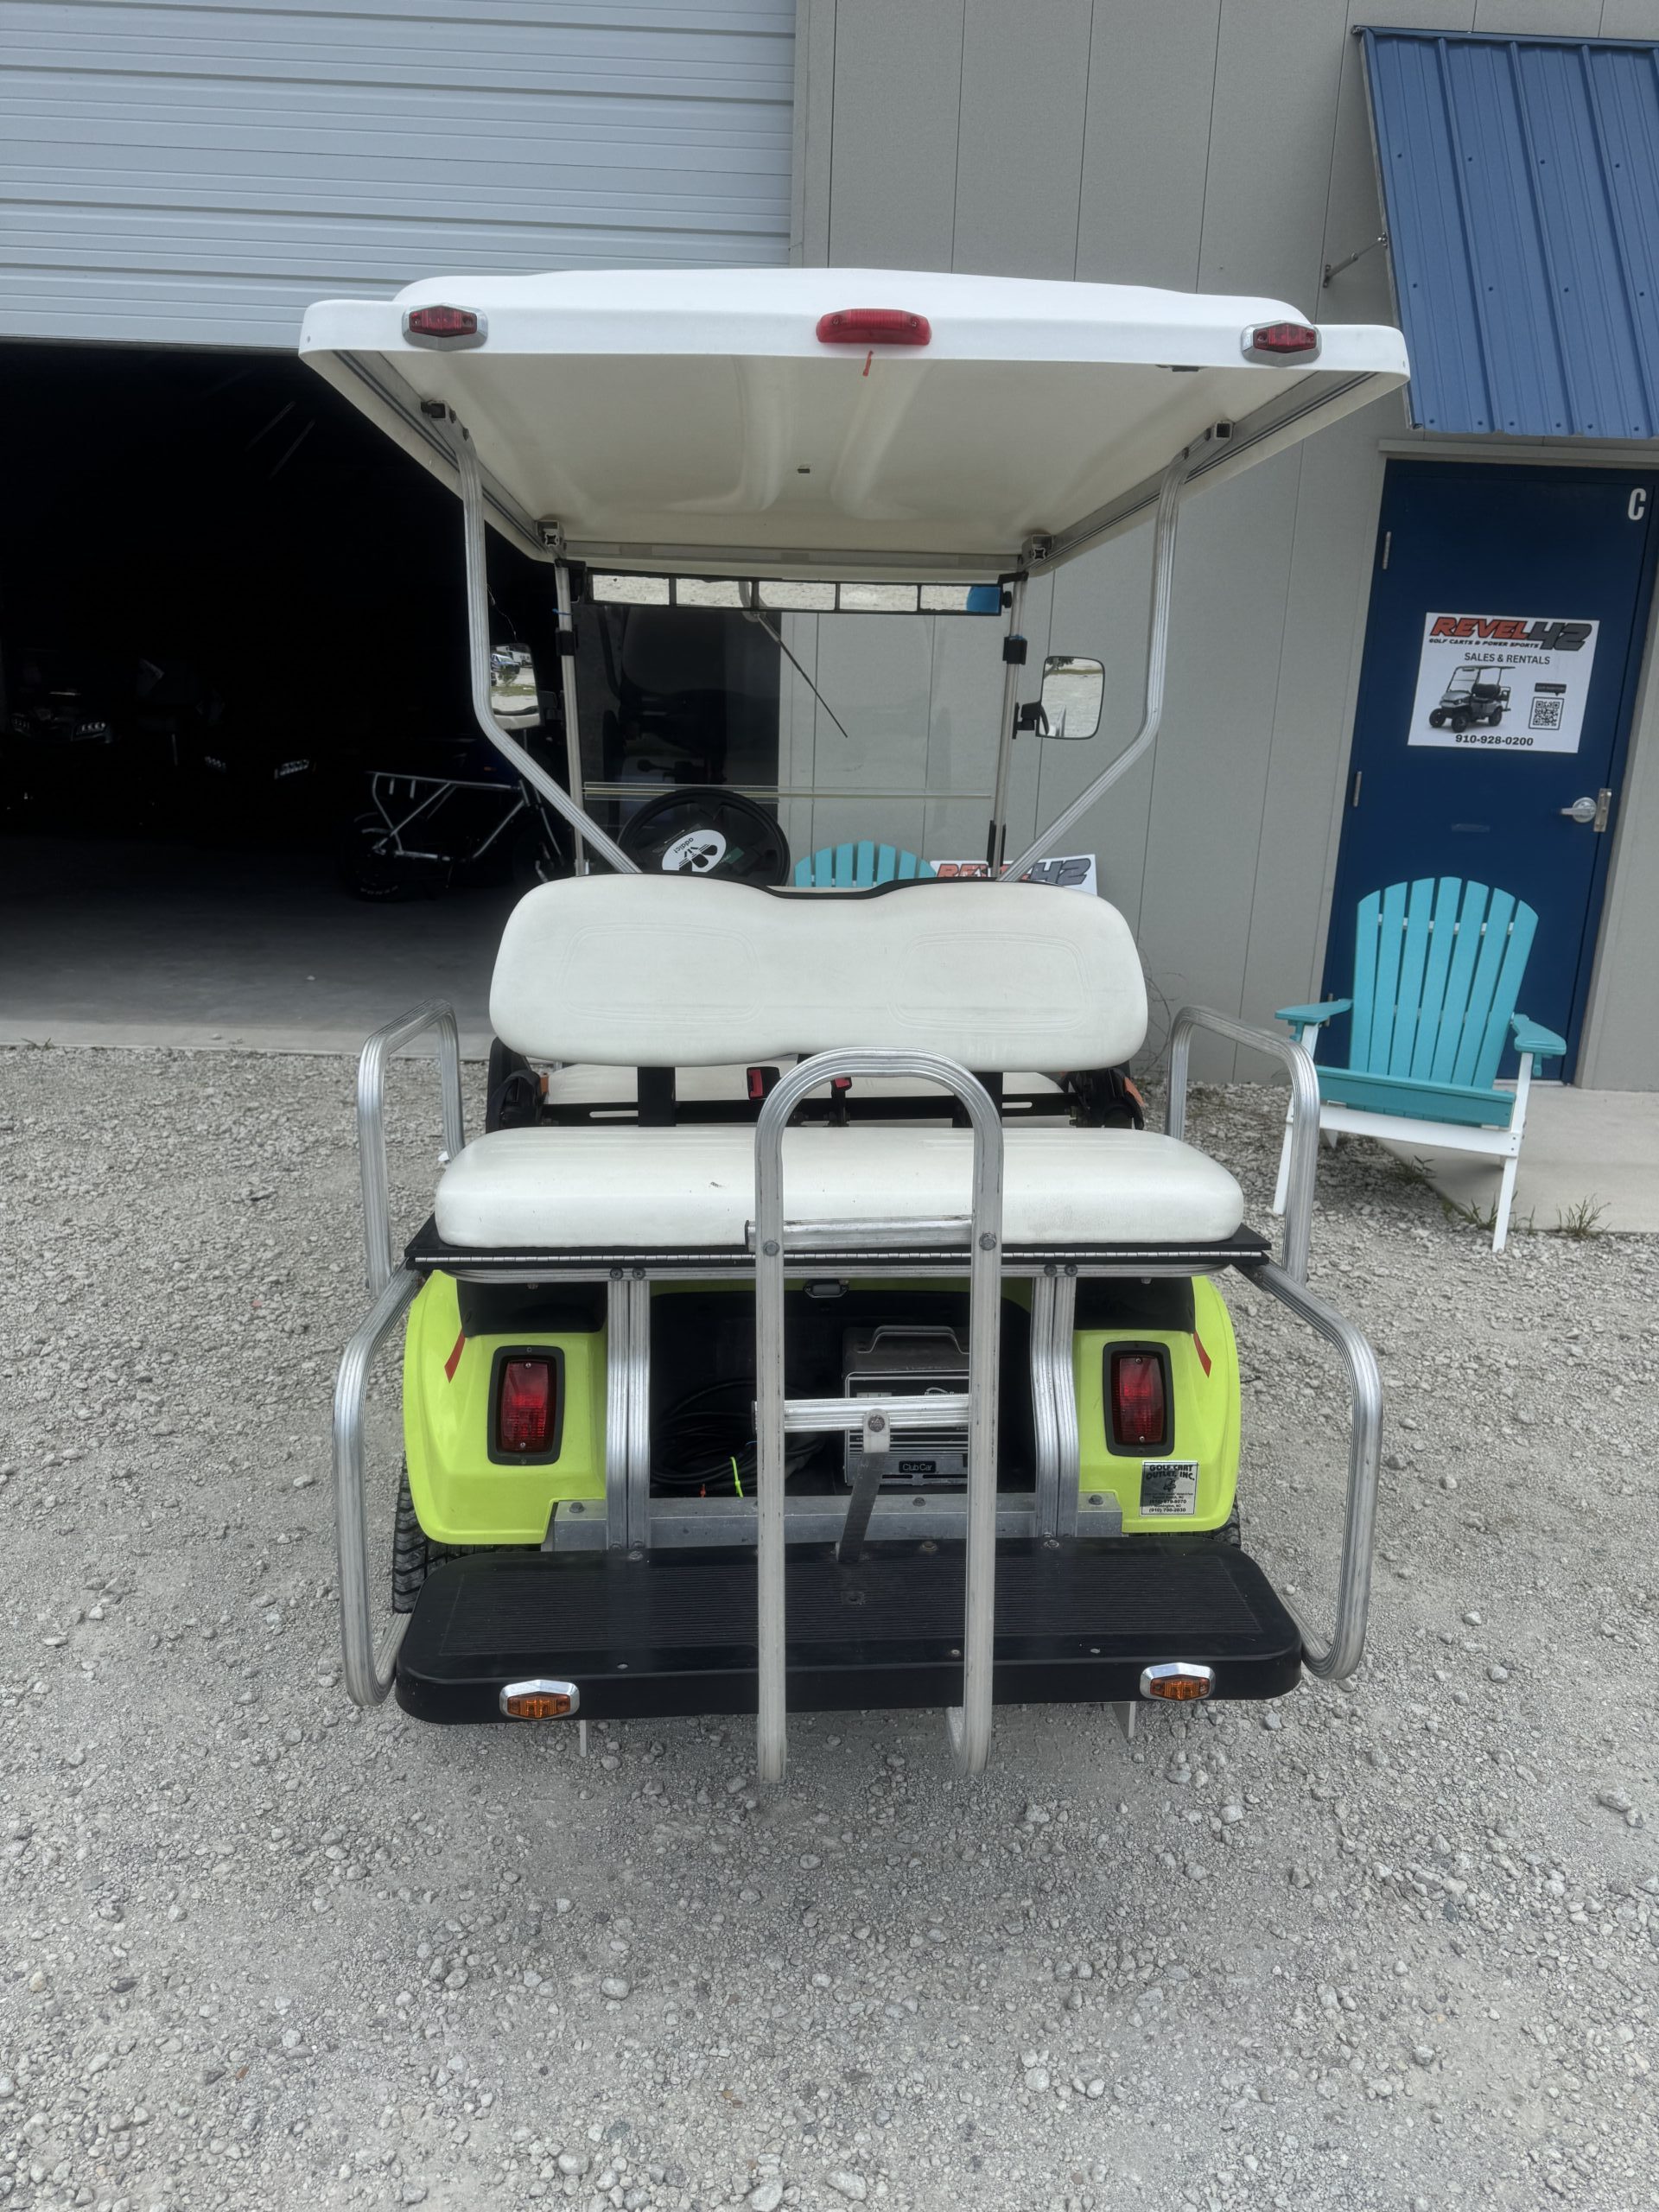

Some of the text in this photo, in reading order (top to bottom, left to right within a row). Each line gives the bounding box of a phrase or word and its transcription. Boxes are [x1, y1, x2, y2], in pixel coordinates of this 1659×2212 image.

[1627, 487, 1647, 521] C
[1464, 652, 1551, 665] SALES & RENTALS
[1455, 734, 1534, 747] 910-928-0200
[672, 836, 695, 855] addict
[902, 1463, 933, 1471] Club Car
[1179, 1471, 1195, 1481] INC.
